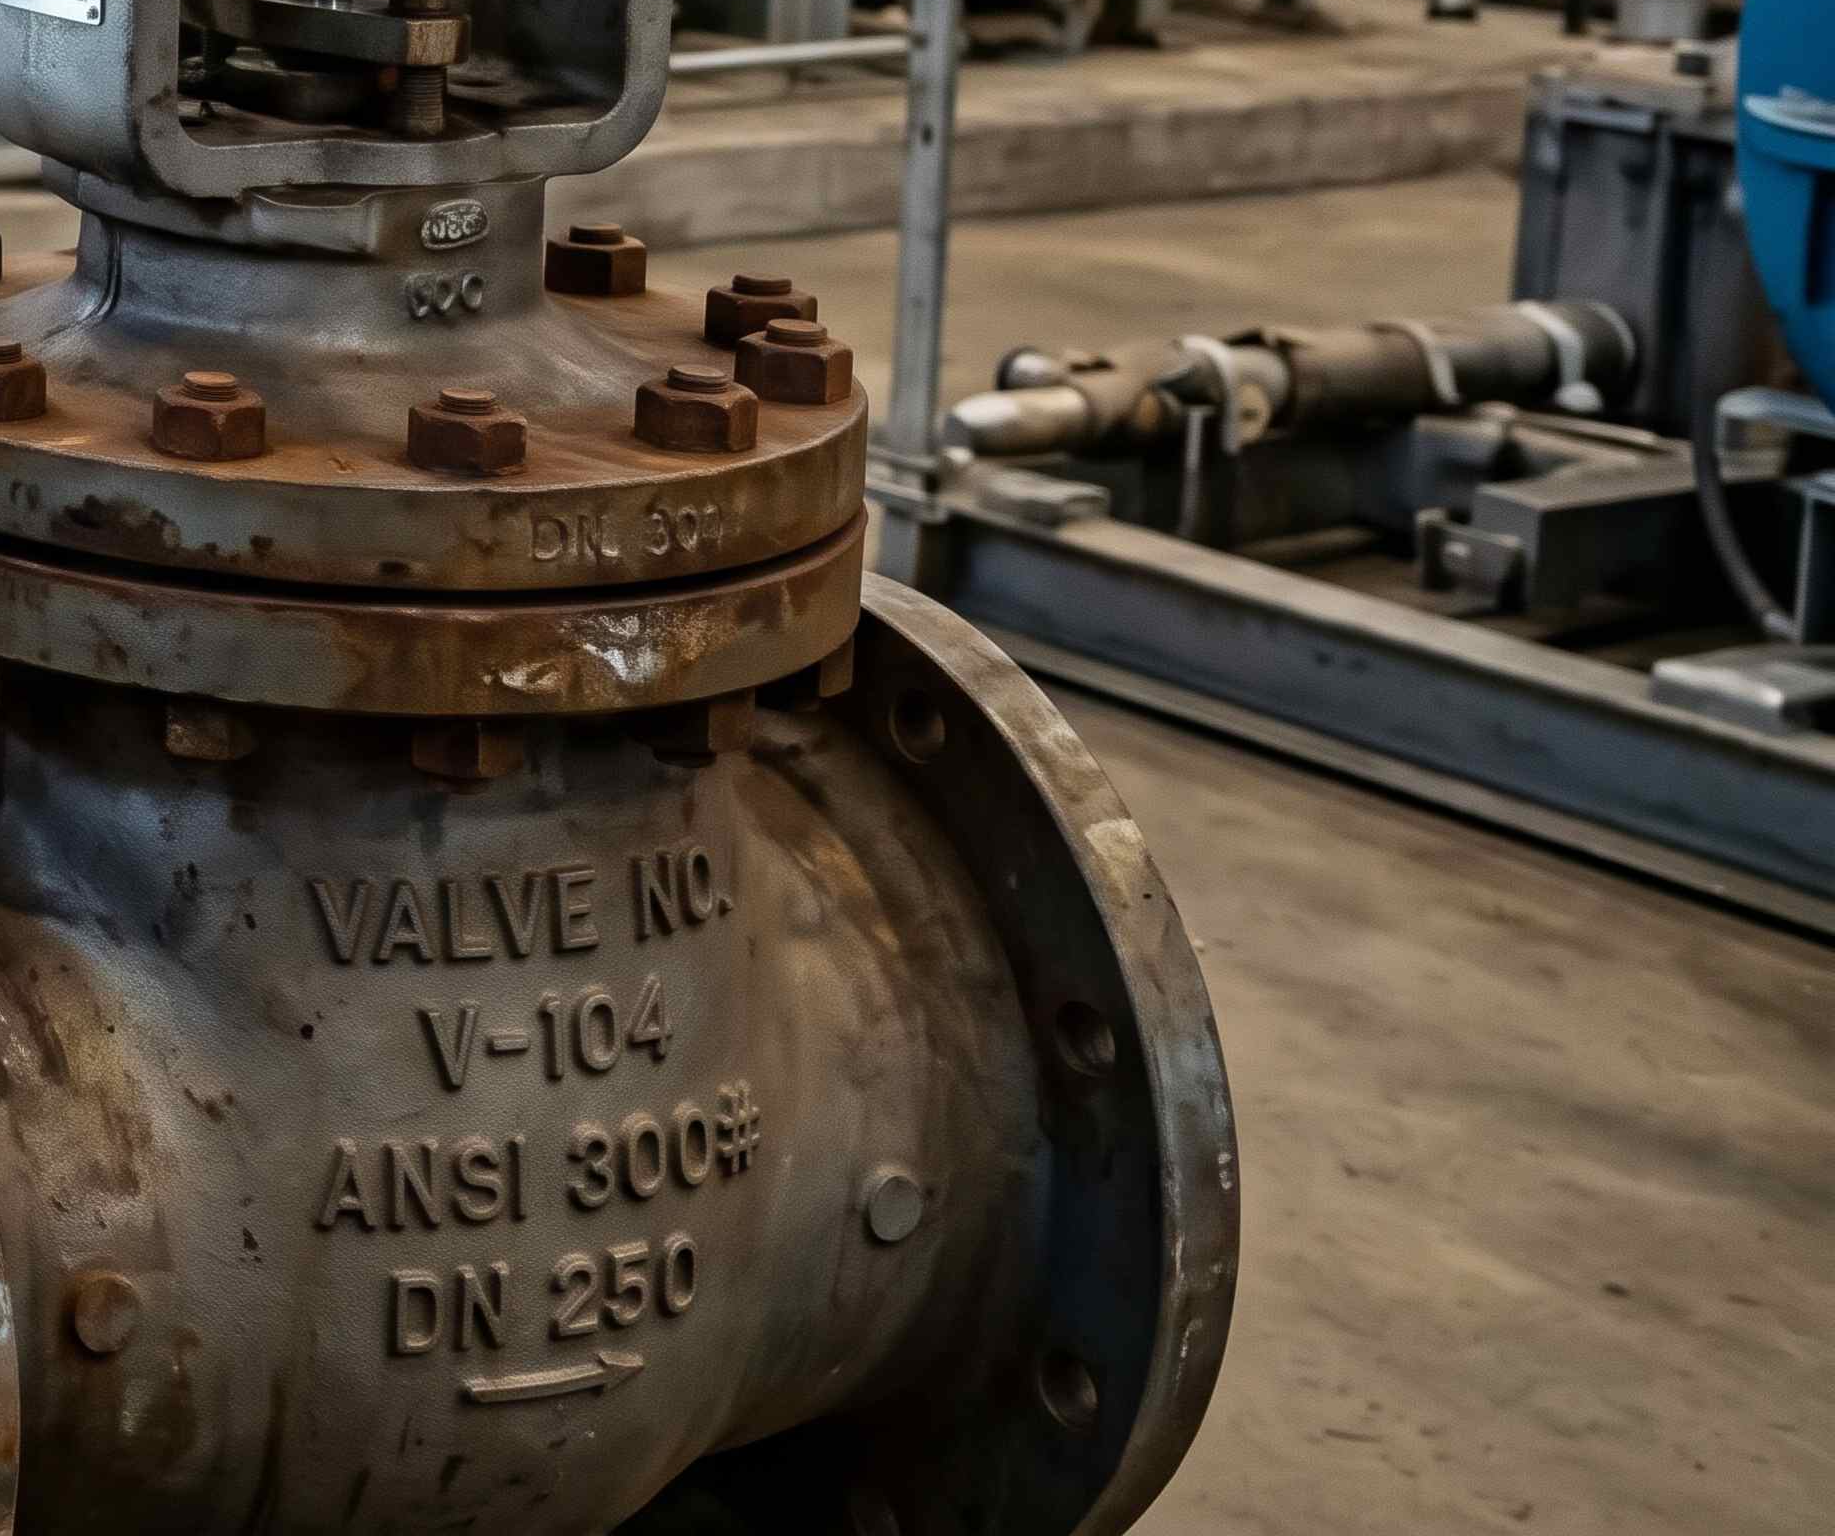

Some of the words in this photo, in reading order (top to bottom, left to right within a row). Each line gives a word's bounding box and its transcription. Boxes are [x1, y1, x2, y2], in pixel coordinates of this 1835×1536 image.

[313, 866, 601, 963] VALVE
[635, 844, 733, 942] NO.
[421, 972, 674, 1089] V-104
[314, 1133, 527, 1229] ANSI
[567, 1077, 762, 1210] 300#
[387, 1261, 509, 1356] DN
[549, 1231, 700, 1340] 250
